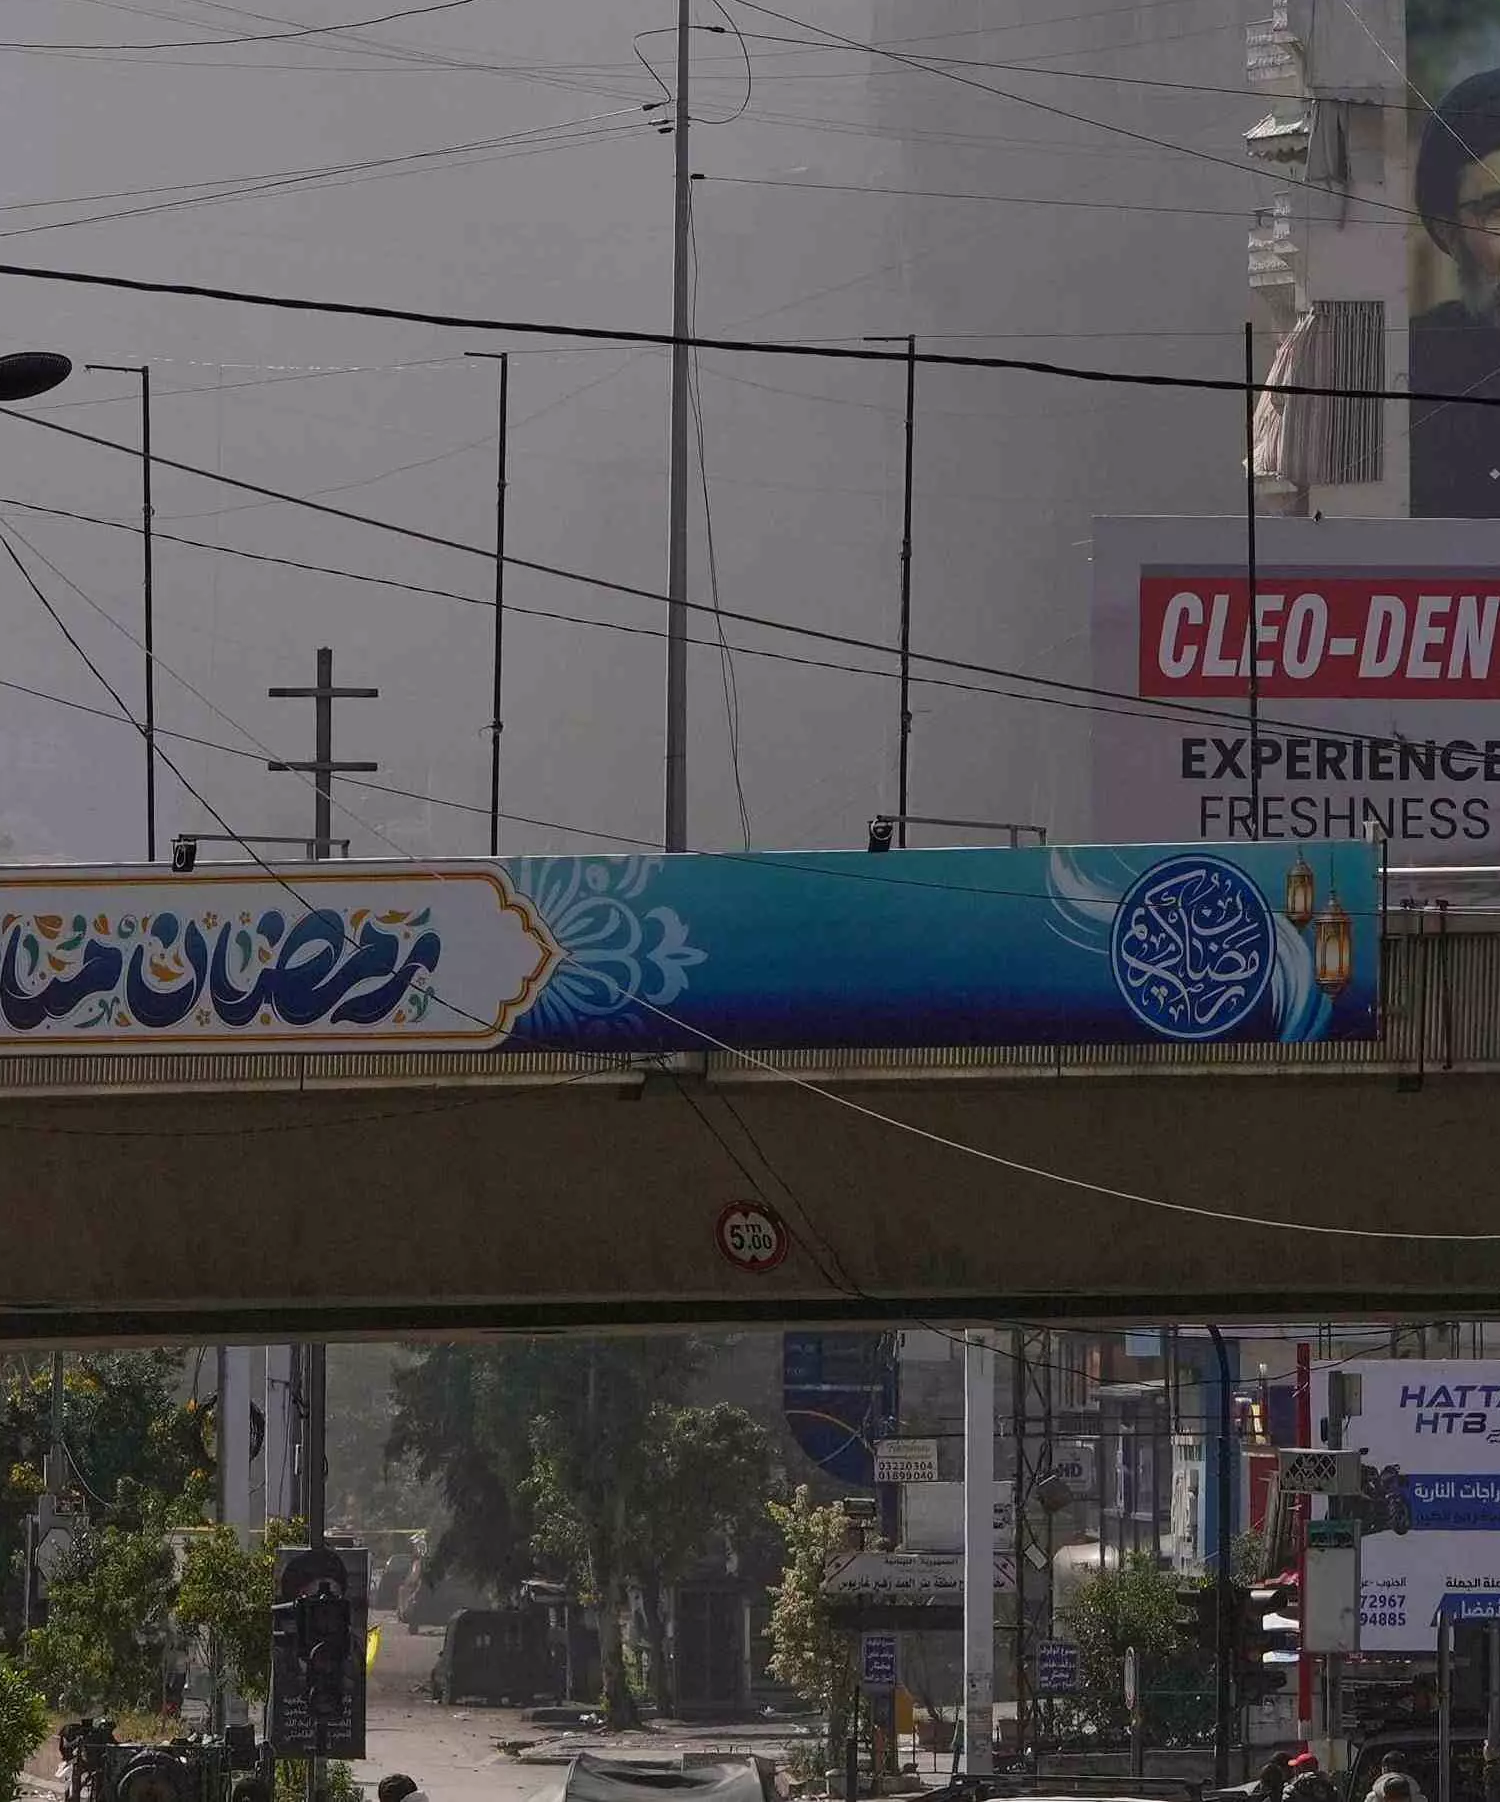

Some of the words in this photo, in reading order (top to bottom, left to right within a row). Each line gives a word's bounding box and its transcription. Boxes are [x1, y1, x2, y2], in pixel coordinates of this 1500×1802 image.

[1201, 797, 1491, 840] FRESHNESS
[125, 908, 441, 1028] رمضان
[1415, 1412, 1487, 1434] HTB
[1414, 1482, 1455, 1501] النارية
